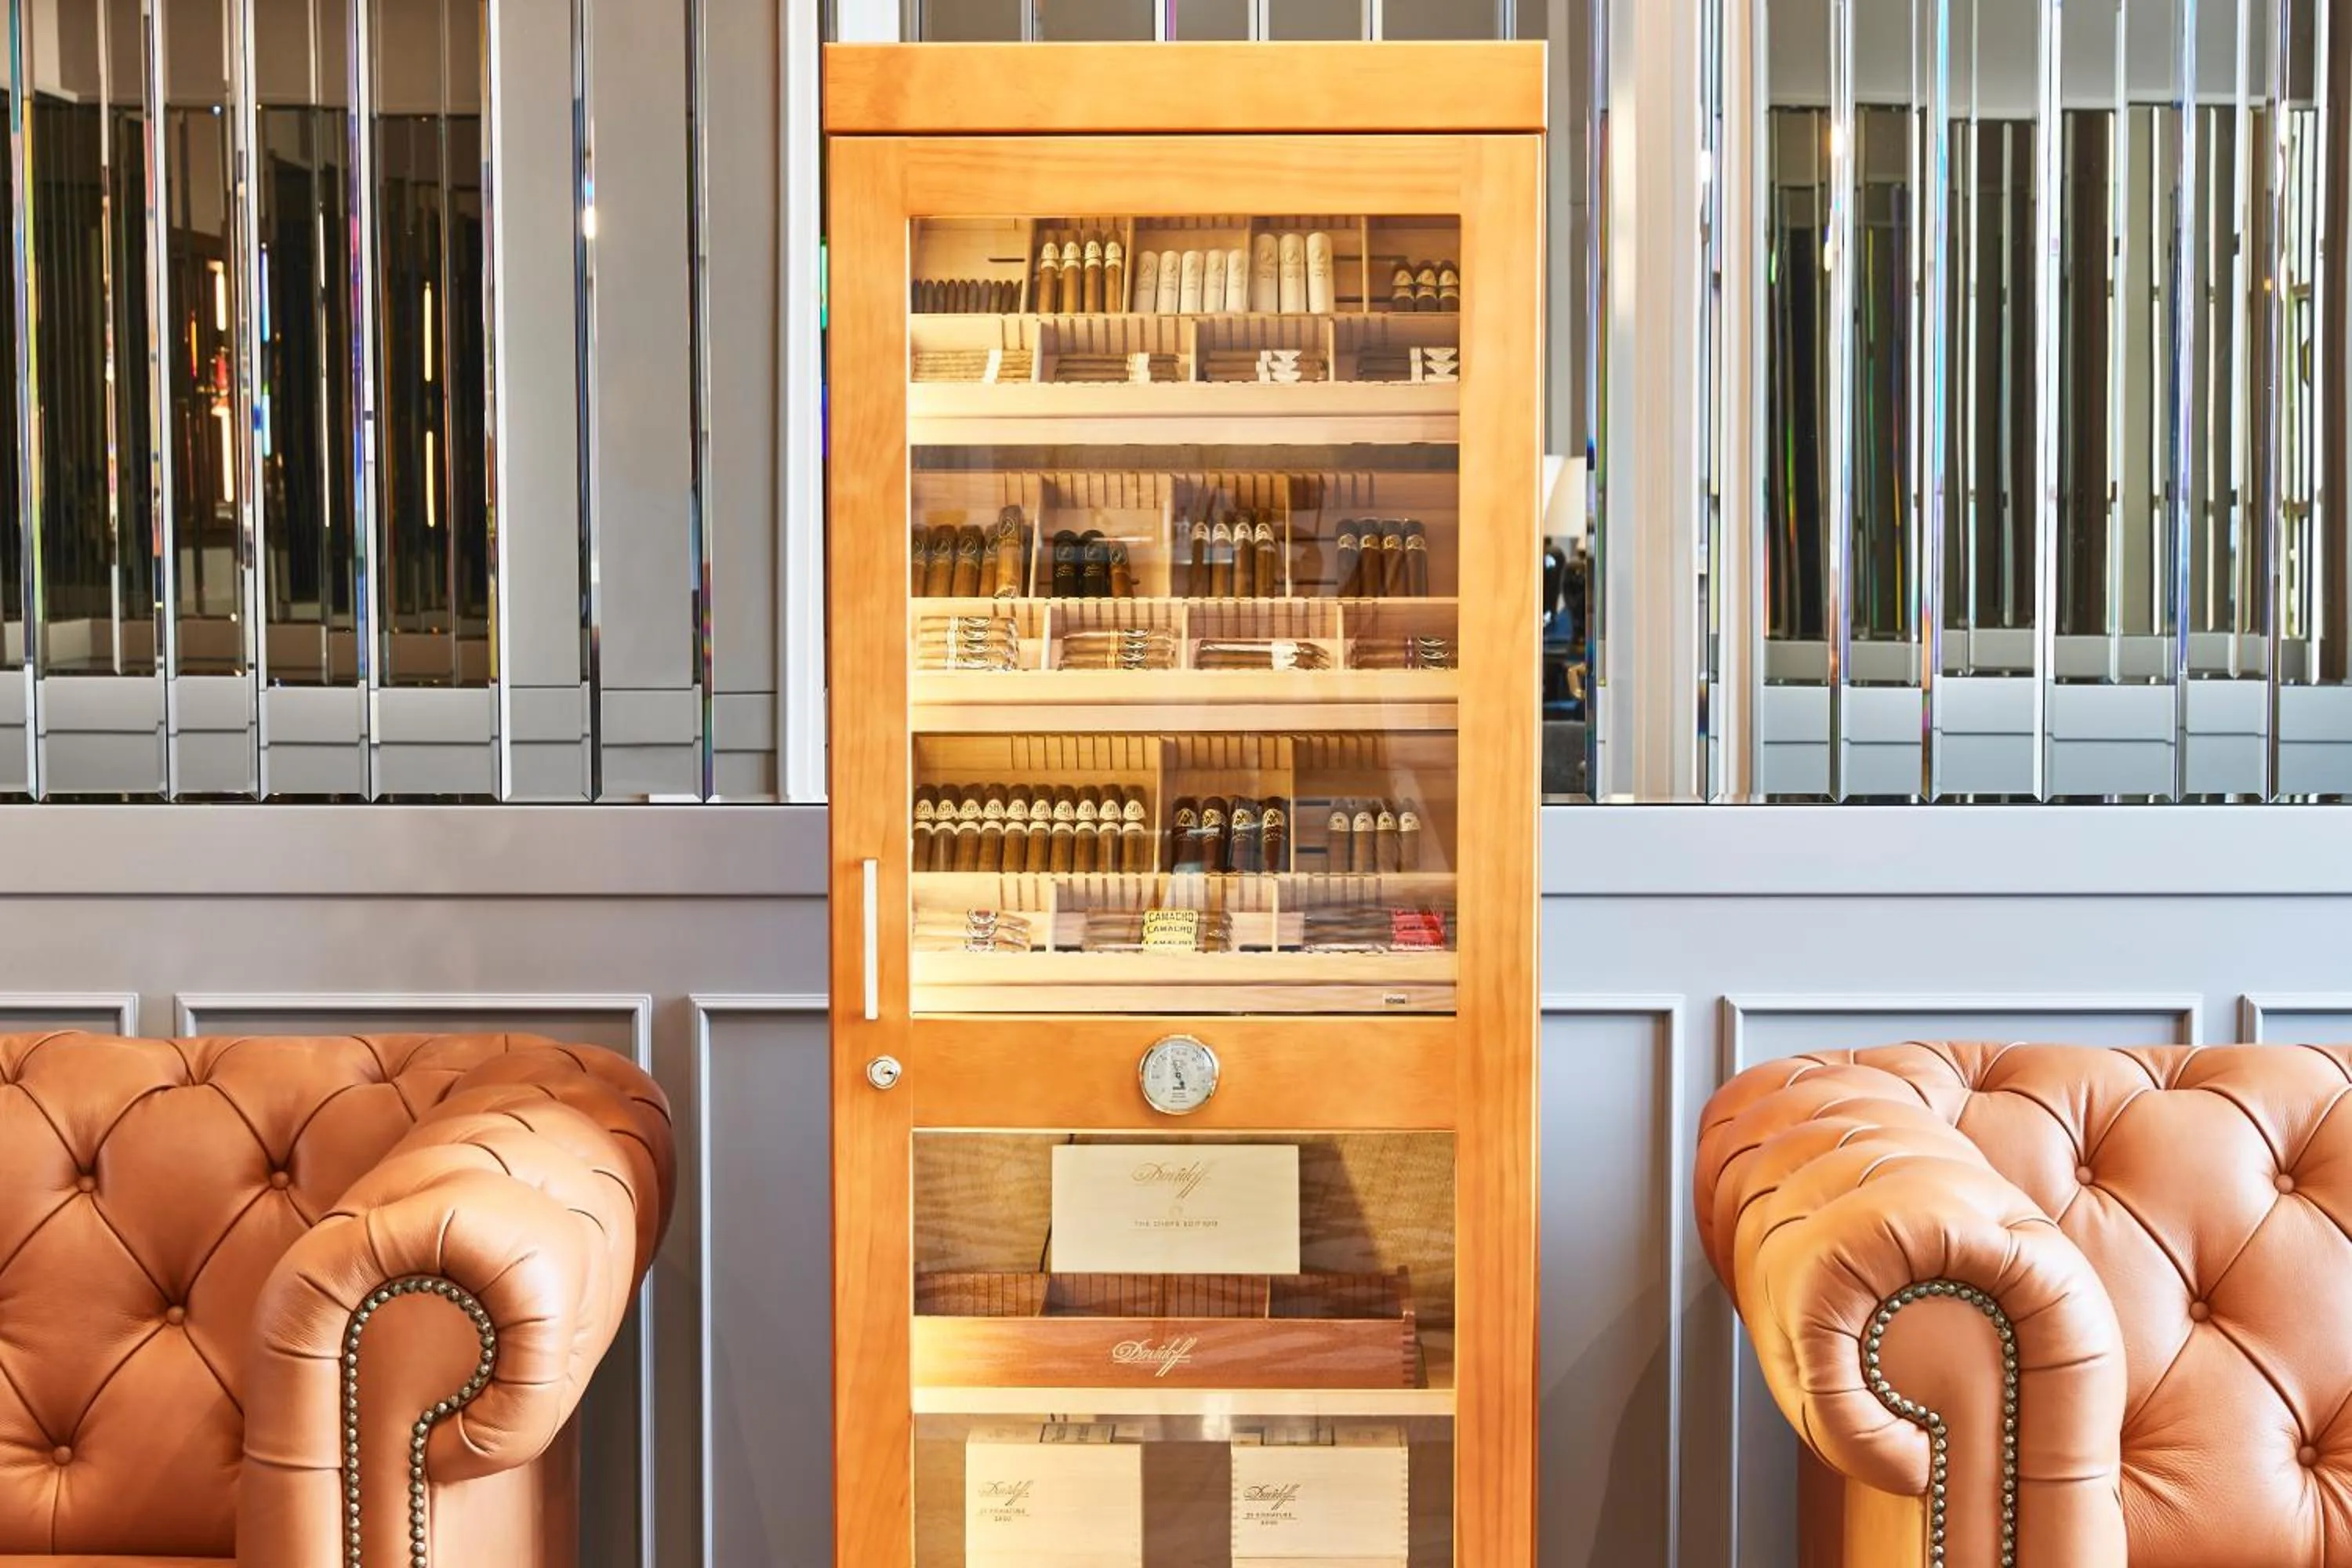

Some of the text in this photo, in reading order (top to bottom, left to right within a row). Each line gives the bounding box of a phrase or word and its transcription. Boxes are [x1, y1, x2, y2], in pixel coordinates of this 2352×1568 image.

[1149, 912, 1194, 923] CAMACHO
[1112, 1338, 1197, 1377] Davidoff
[1243, 1483, 1301, 1511] Davidoff
